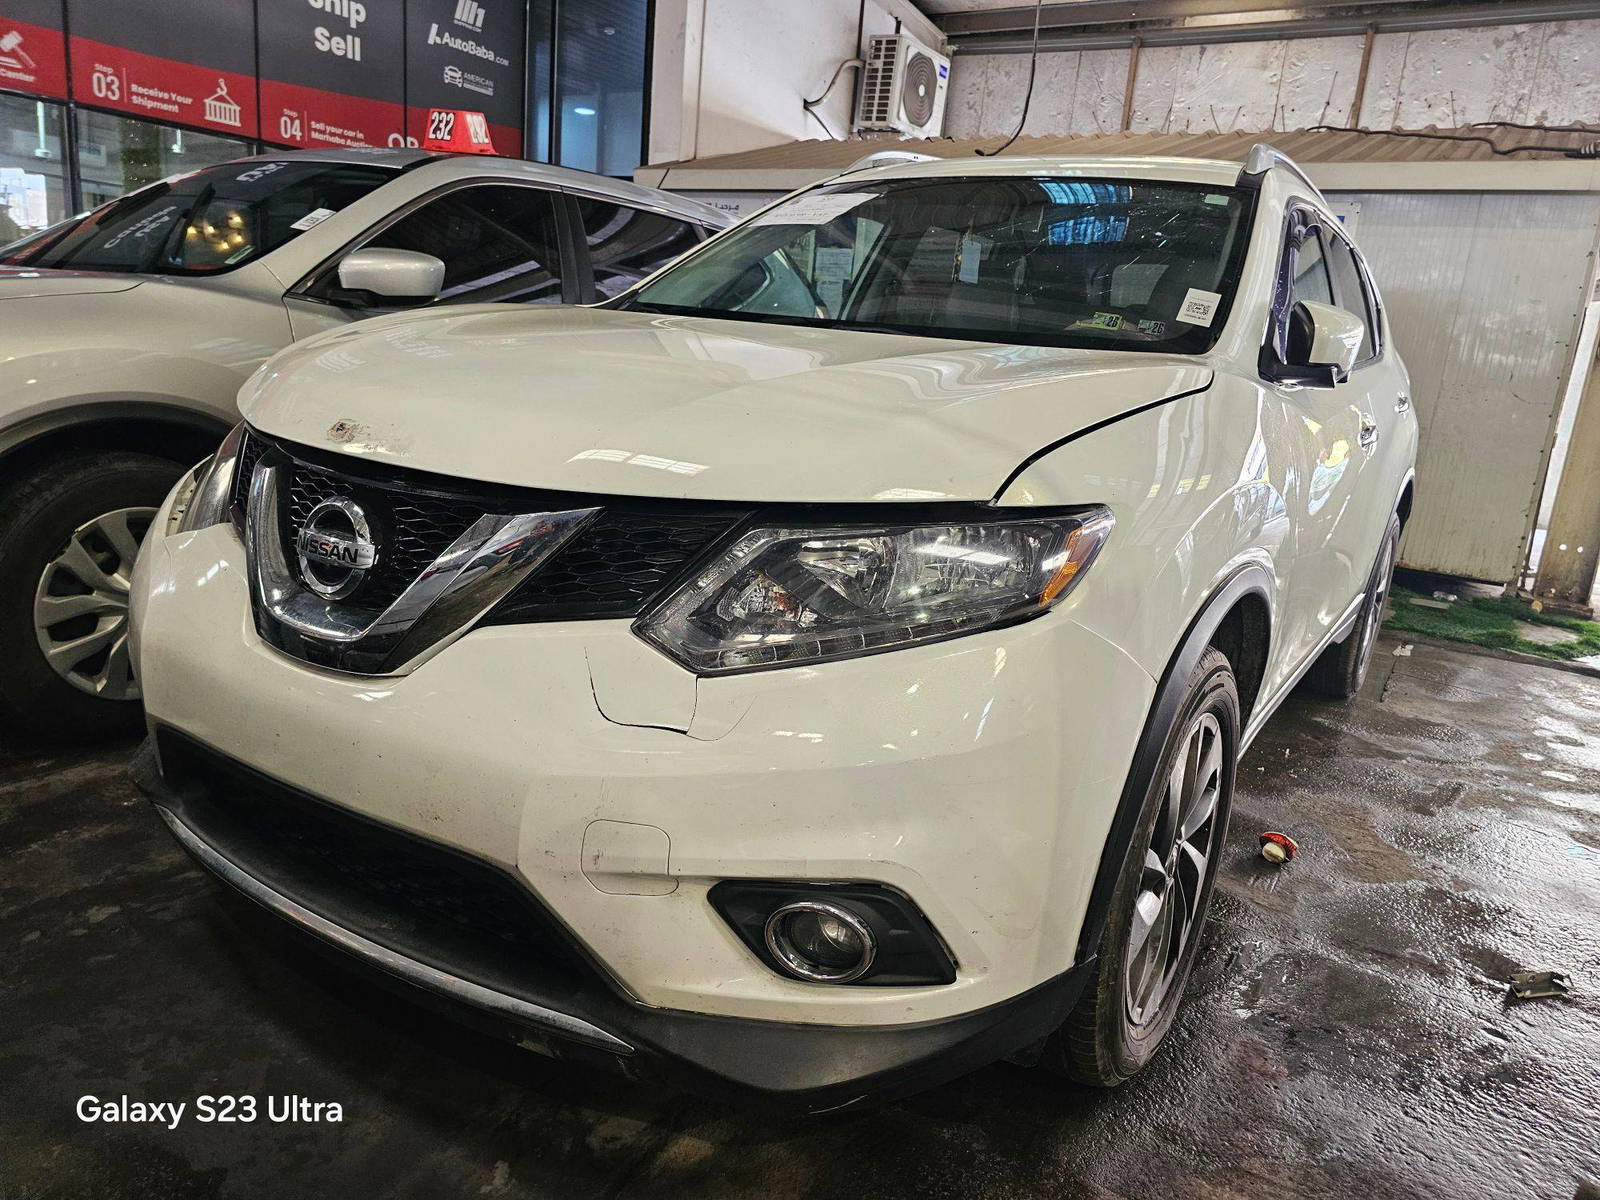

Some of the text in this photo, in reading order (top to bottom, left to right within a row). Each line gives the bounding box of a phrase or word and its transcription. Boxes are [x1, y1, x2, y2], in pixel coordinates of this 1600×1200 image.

[314, 26, 361, 61] Sell
[92, 72, 120, 101] 03
[131, 83, 193, 105] Receive Your
[131, 95, 179, 113] Shipment
[280, 116, 302, 141] 04
[310, 120, 325, 131] Sell
[428, 111, 455, 141] 232
[299, 531, 359, 564] NISSAN
